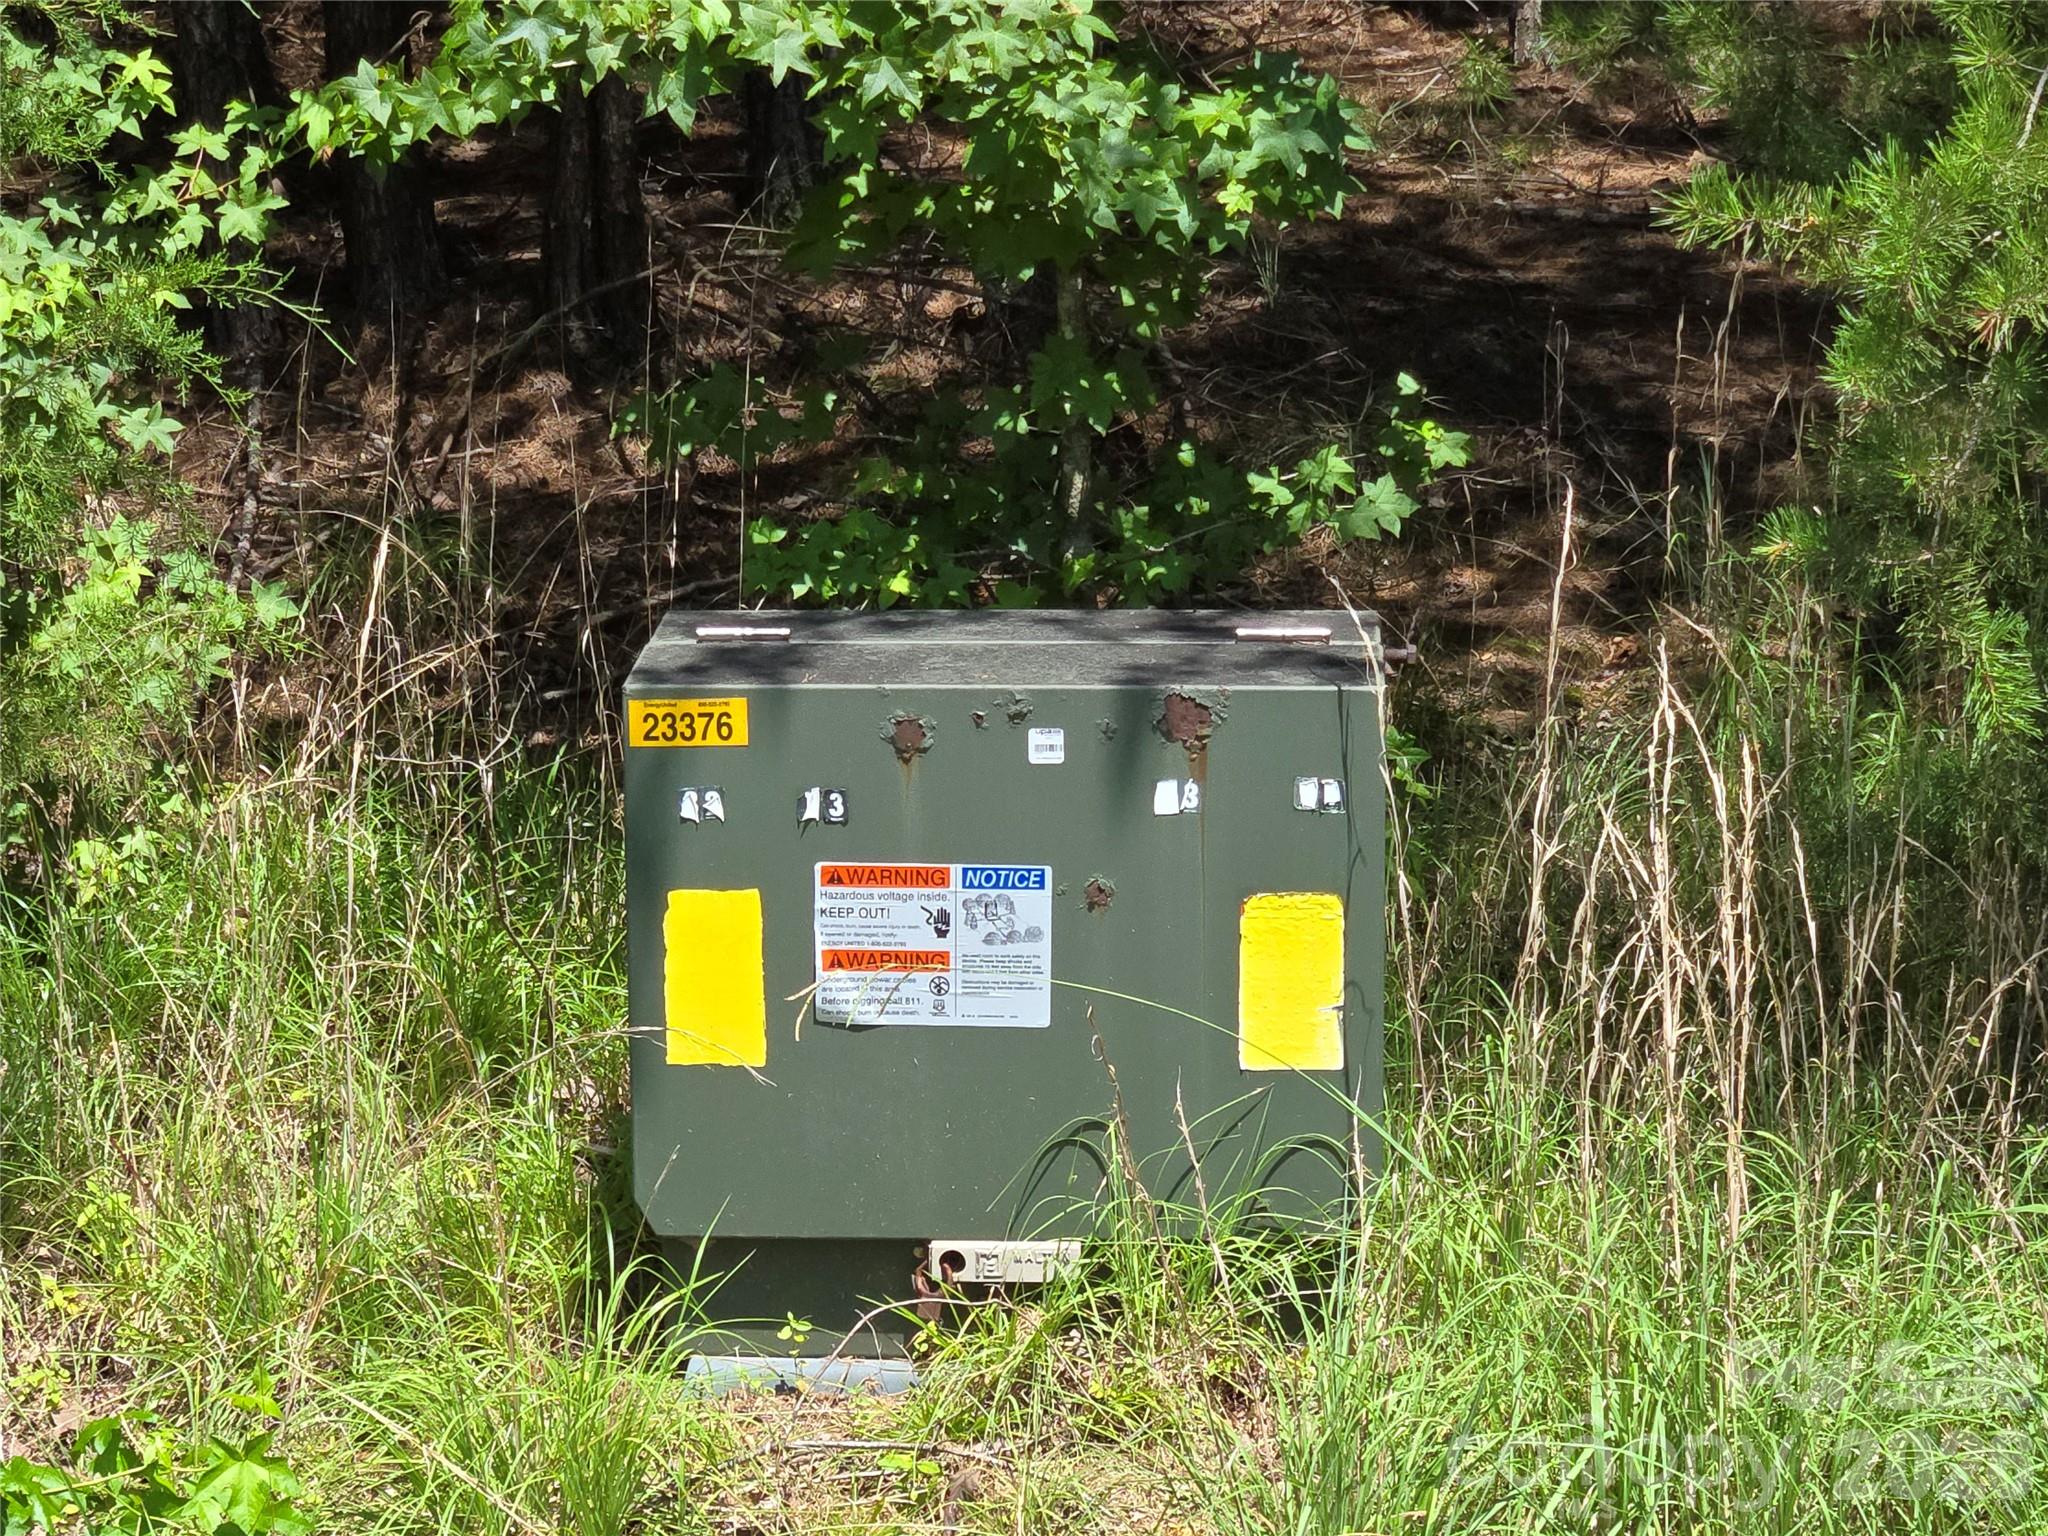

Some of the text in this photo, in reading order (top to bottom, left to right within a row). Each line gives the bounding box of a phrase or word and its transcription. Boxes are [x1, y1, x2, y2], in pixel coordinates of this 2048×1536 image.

[643, 712, 733, 741] 23376
[847, 869, 945, 886] WARNING
[966, 870, 1042, 887] NOTICE
[820, 890, 950, 903] Hazardous voltage inside.
[820, 907, 891, 919] KEEP OUT!
[847, 953, 945, 969] WARNING
[821, 976, 867, 985] derground
[821, 996, 850, 1005] Before
[852, 996, 885, 1006] dgging
